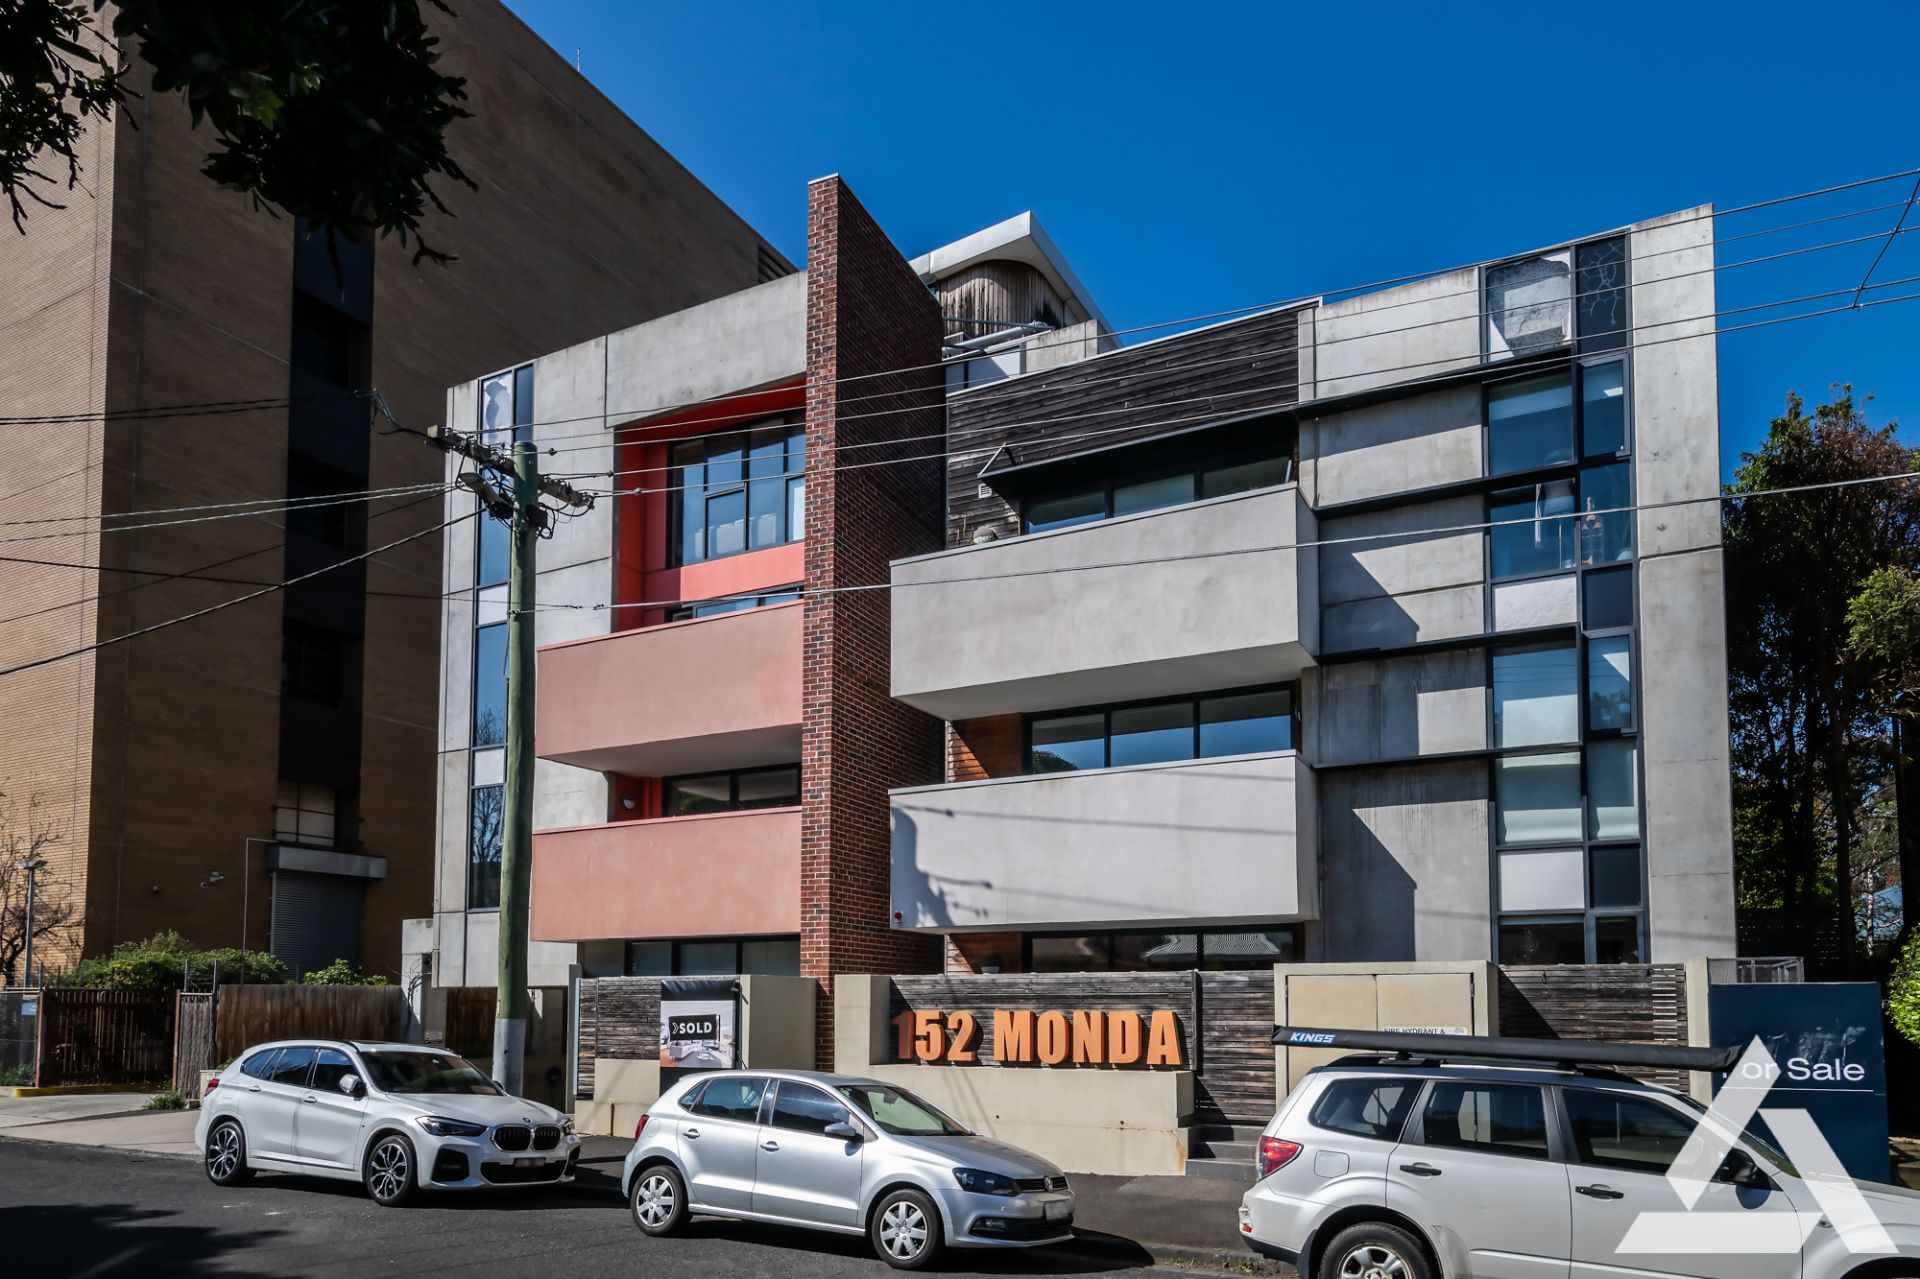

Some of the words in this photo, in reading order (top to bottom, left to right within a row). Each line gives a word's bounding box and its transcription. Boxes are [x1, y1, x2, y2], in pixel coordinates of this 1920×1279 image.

[679, 1022, 713, 1034] SOLD
[893, 1010, 976, 1062] 152
[993, 1008, 1183, 1065] MONDA
[1289, 1032, 1336, 1043] KINGS
[1787, 1057, 1865, 1081] Sale
